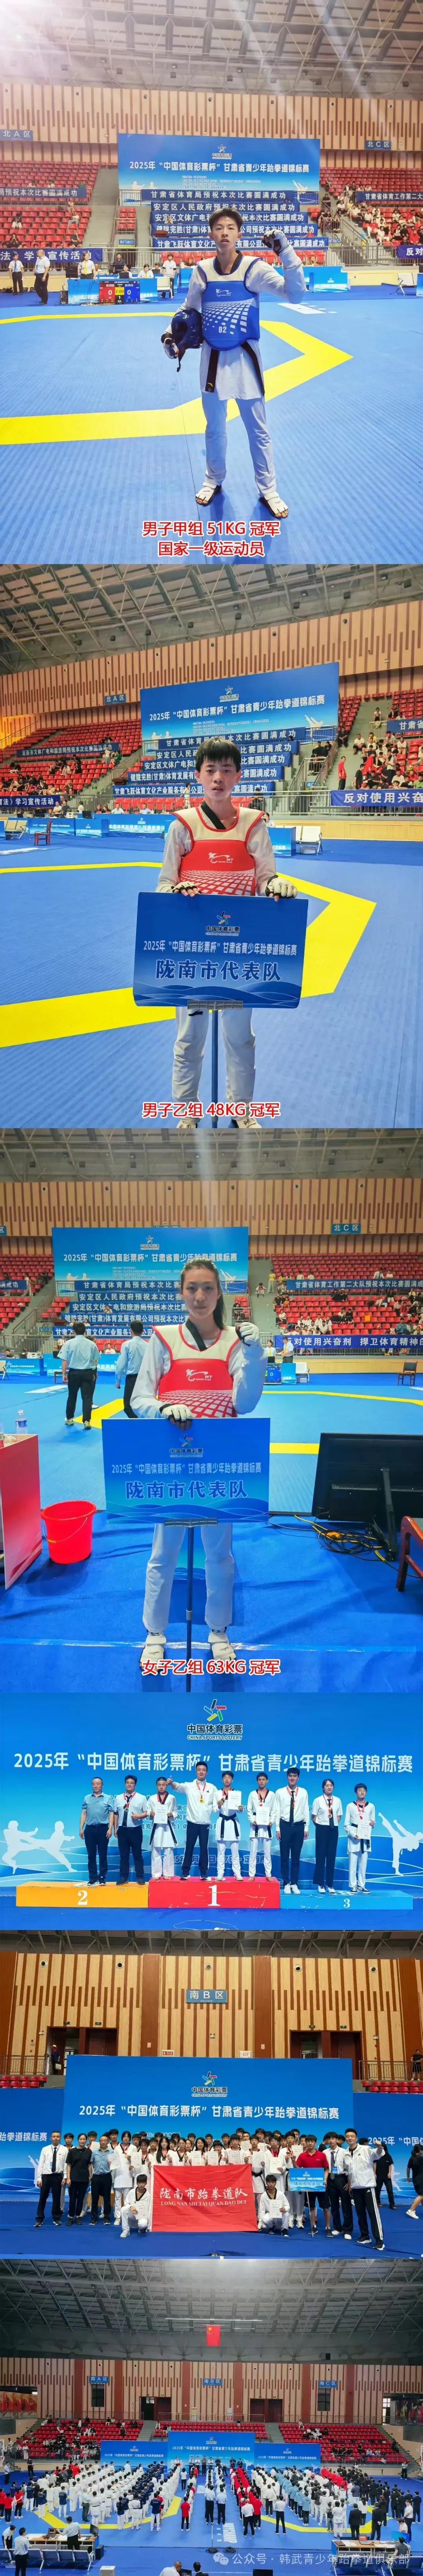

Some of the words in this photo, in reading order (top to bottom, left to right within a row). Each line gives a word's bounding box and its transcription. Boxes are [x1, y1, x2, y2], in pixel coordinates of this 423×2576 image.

[130, 161, 155, 170] 2025年
[224, 163, 309, 173] 甘肃省青少年跆拳道锦标赛
[151, 191, 286, 199] 甘肃省体育局预祝本次比赛圆满成功
[150, 712, 170, 721] 2025年
[231, 695, 325, 714] 甘肃省青少年跆拳道锦标赛
[143, 941, 165, 952] 2025年
[223, 942, 297, 956] 甘肃省青少年跆拳道锦标赛
[156, 959, 282, 982] 陇南市代表队
[112, 1464, 132, 1474] 2025年
[188, 1462, 261, 1474] 甘肃省青少年跆拳道锦标赛
[125, 1480, 248, 1499] 陇南市代表队
[187, 1724, 243, 1734] 中国体育彩票
[14, 1753, 69, 1770] 2025年
[219, 1754, 412, 1773] 甘肃省青少年跆拳道锦标赛
[78, 1890, 88, 1905] 2
[208, 1885, 221, 1906] 1
[343, 1899, 350, 1908] 3
[190, 1990, 224, 1999] 南B区
[79, 2105, 116, 2117] 2025年
[212, 2106, 339, 2119] 甘肃省青少年跆拳道锦标赛
[160, 2187, 248, 2201] 陇南市跆拳道队
